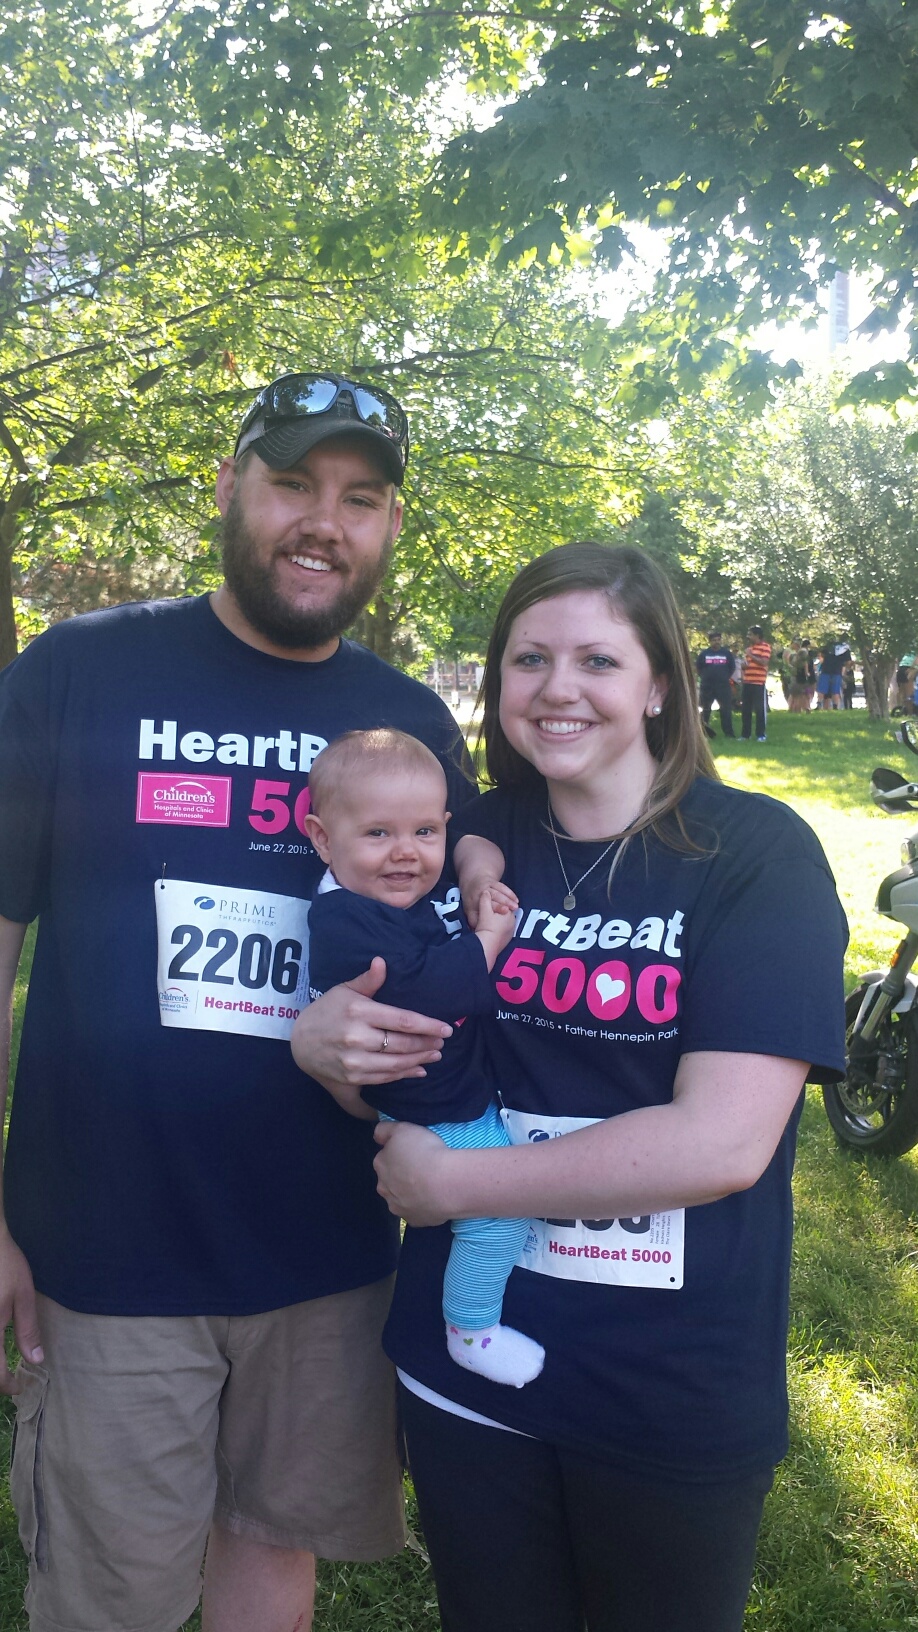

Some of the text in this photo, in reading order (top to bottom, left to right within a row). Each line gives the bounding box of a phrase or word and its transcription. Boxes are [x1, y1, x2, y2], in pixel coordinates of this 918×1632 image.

[153, 787, 216, 804] Children's
[154, 804, 182, 812] Hospitals
[195, 806, 214, 814] Clinics
[172, 811, 204, 819] Minnesota
[248, 841, 308, 855] June 27, 2015
[219, 899, 276, 919] PRIME
[168, 924, 303, 995] 2206
[495, 947, 682, 1024] 5000
[204, 996, 275, 1017] HeartBeat
[496, 1009, 679, 1044] June 27, 2015 Father Hennepin Park
[549, 1240, 627, 1261] HeartBeat
[631, 1249, 672, 1264] 5000
